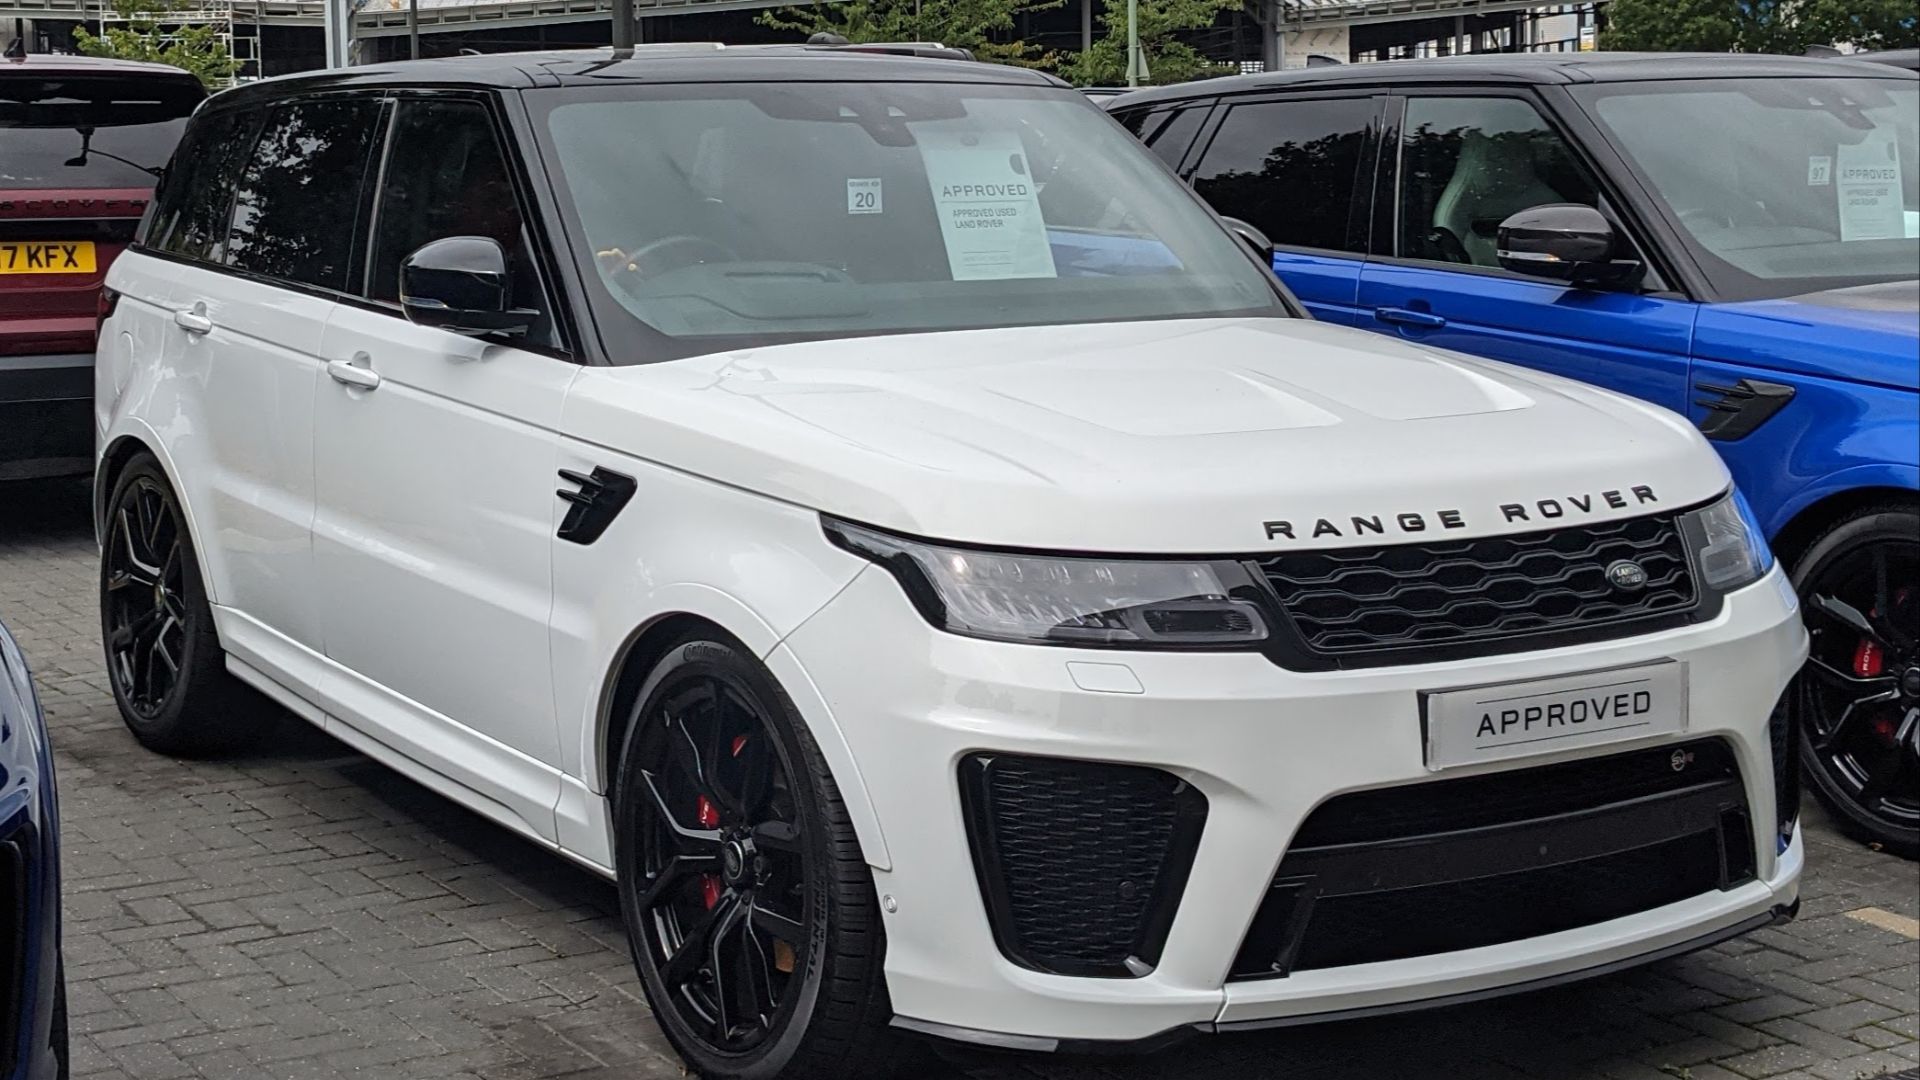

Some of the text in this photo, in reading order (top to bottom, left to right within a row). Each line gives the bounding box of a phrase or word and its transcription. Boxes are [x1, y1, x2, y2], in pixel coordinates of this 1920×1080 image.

[1842, 168, 1897, 180] APPROVED
[942, 184, 1028, 198] APPROVED
[855, 191, 876, 208] 20
[952, 207, 1018, 218] APPROVED USED
[954, 220, 976, 229] LAND
[0, 245, 79, 269] 7 KFX
[1262, 484, 1659, 541] RANGE ROVER
[1476, 690, 1651, 738] APPROVED
